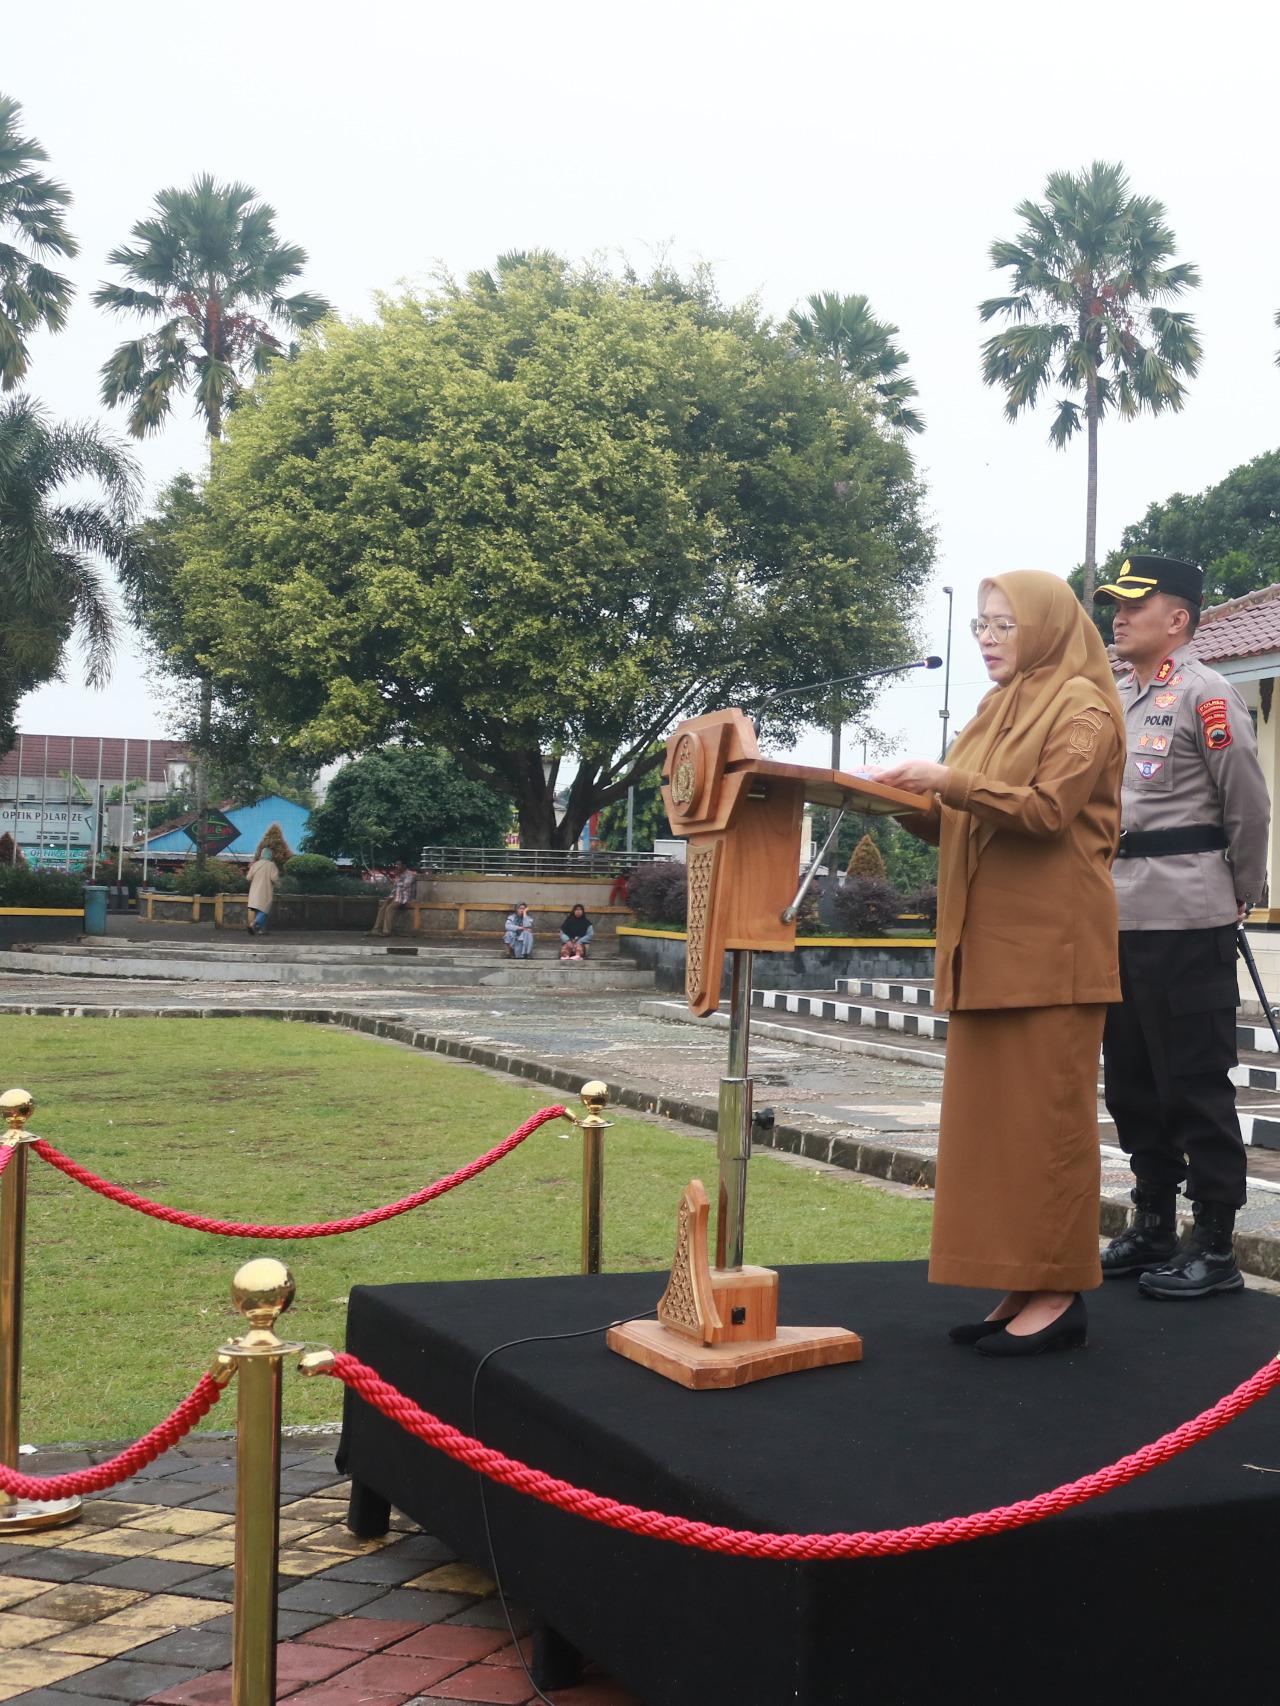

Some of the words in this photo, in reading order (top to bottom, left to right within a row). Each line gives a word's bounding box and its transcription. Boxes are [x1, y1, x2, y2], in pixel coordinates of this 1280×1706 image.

[1144, 715, 1173, 726] POLRI
[2, 811, 32, 820] OPTIK
[35, 812, 82, 822] POLARZE
